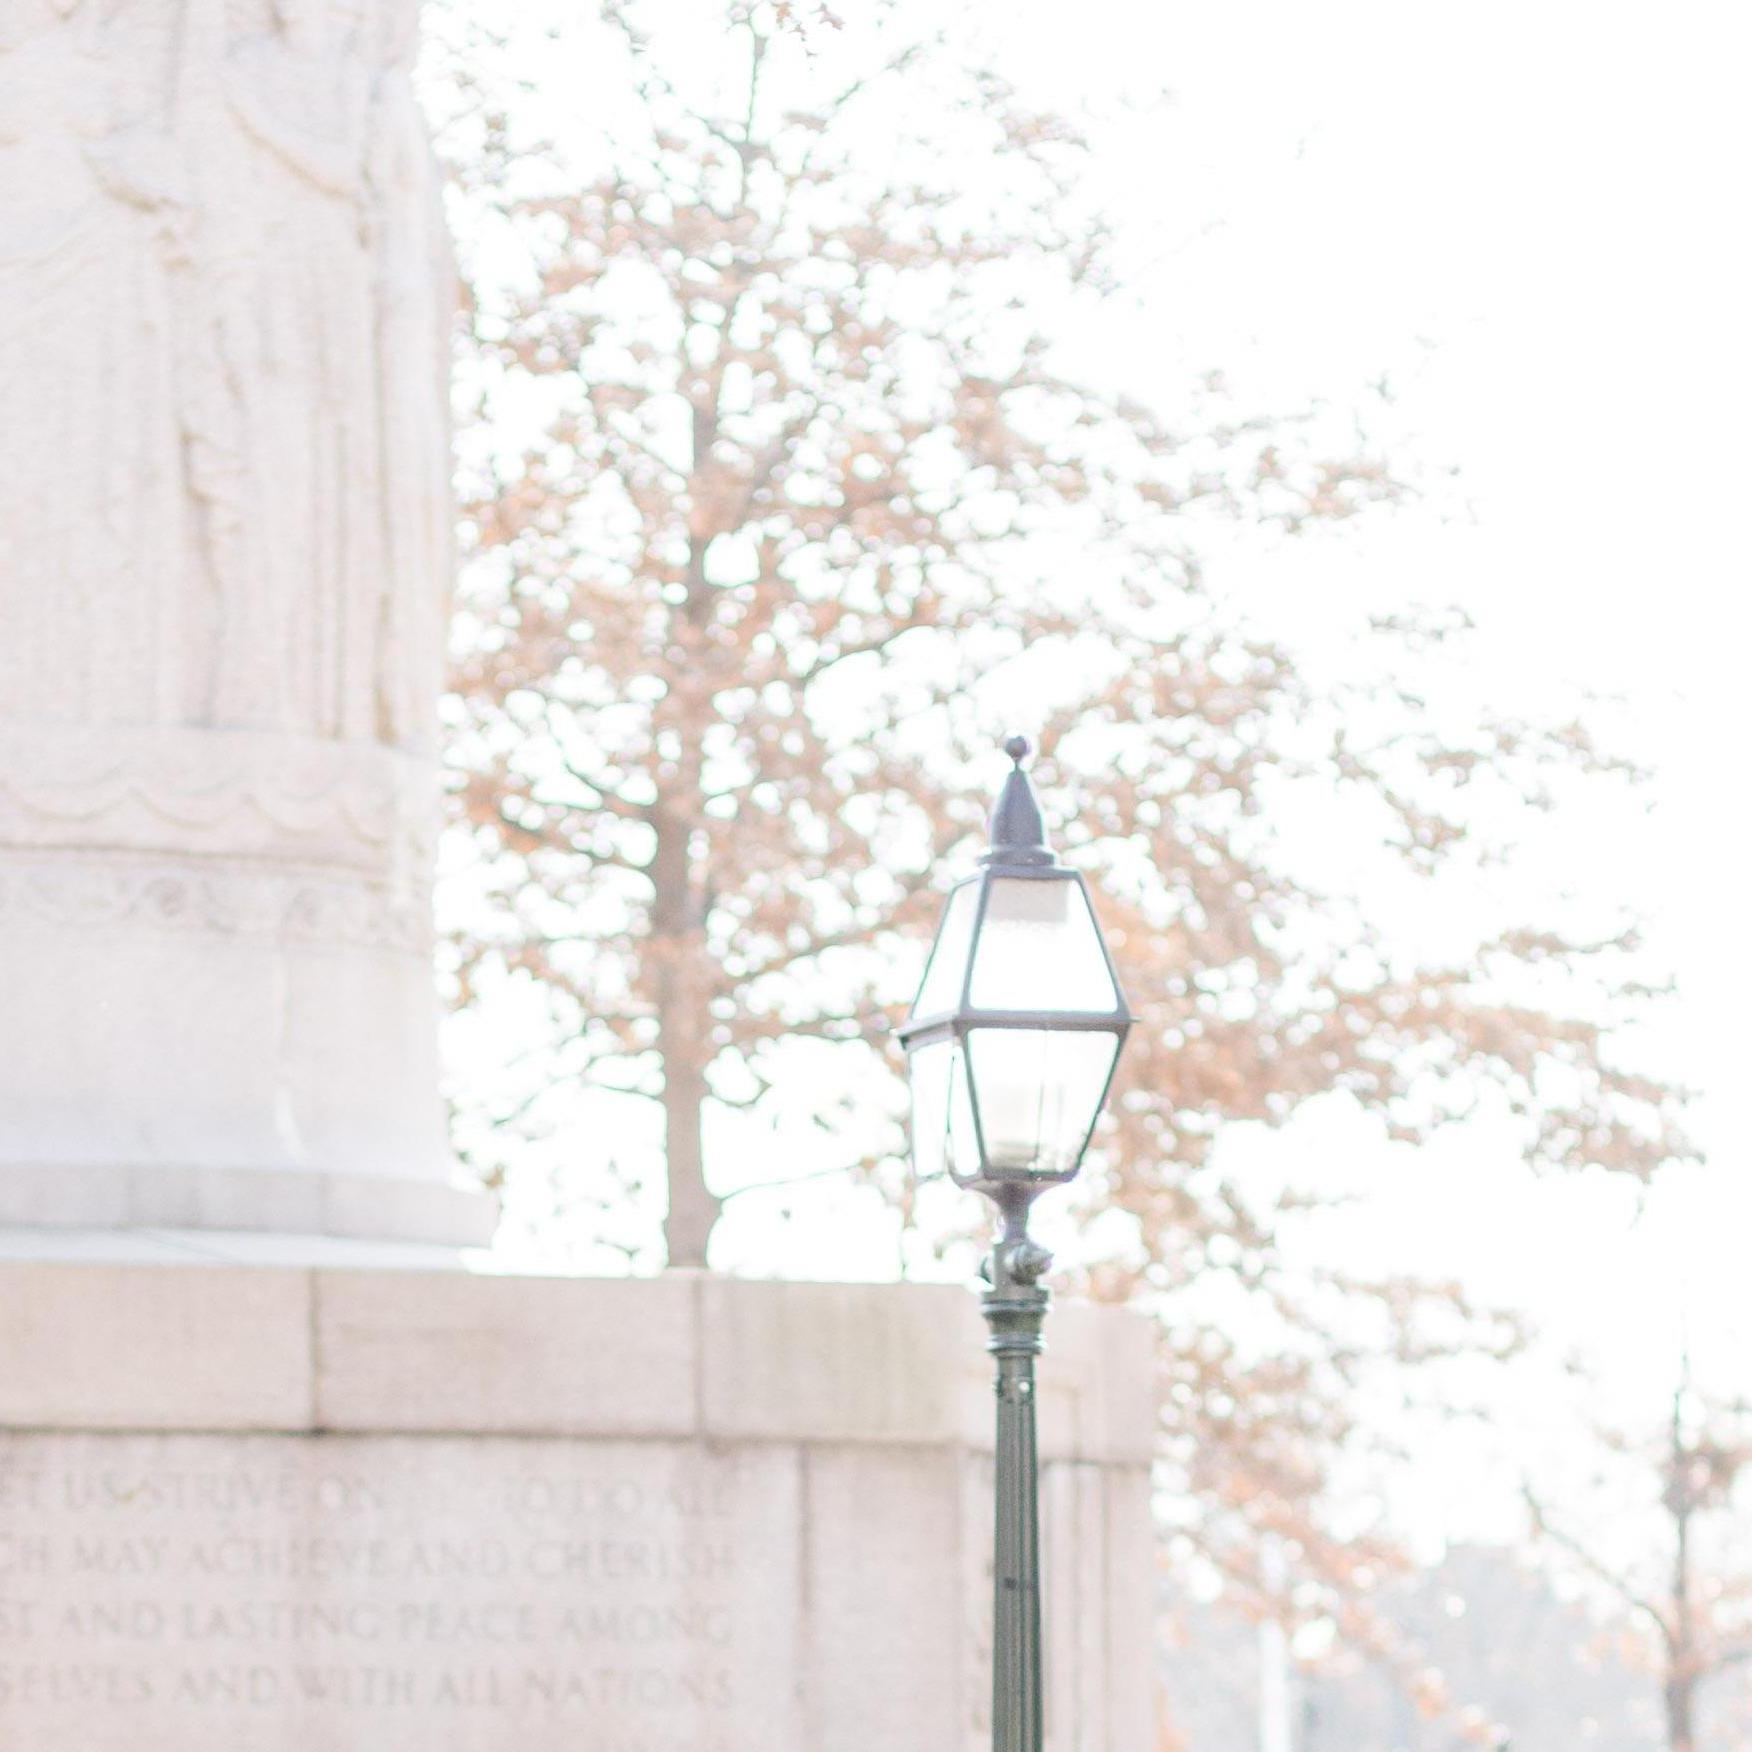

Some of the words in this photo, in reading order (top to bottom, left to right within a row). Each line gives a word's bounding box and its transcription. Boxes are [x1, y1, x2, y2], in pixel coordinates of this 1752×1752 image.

[70, 1534, 169, 1575] MAY
[185, 1535, 390, 1578] ACHIEVE
[405, 1538, 510, 1579] AND
[527, 1538, 737, 1581] CHERISH
[56, 1600, 167, 1639] AND
[179, 1600, 383, 1641] LASTING
[395, 1601, 538, 1643] PEACE
[556, 1604, 735, 1646] AMONG
[170, 1664, 280, 1707] AND
[292, 1665, 418, 1707] WITH
[433, 1666, 508, 1708] ALL
[521, 1666, 737, 1710] NATIONS
